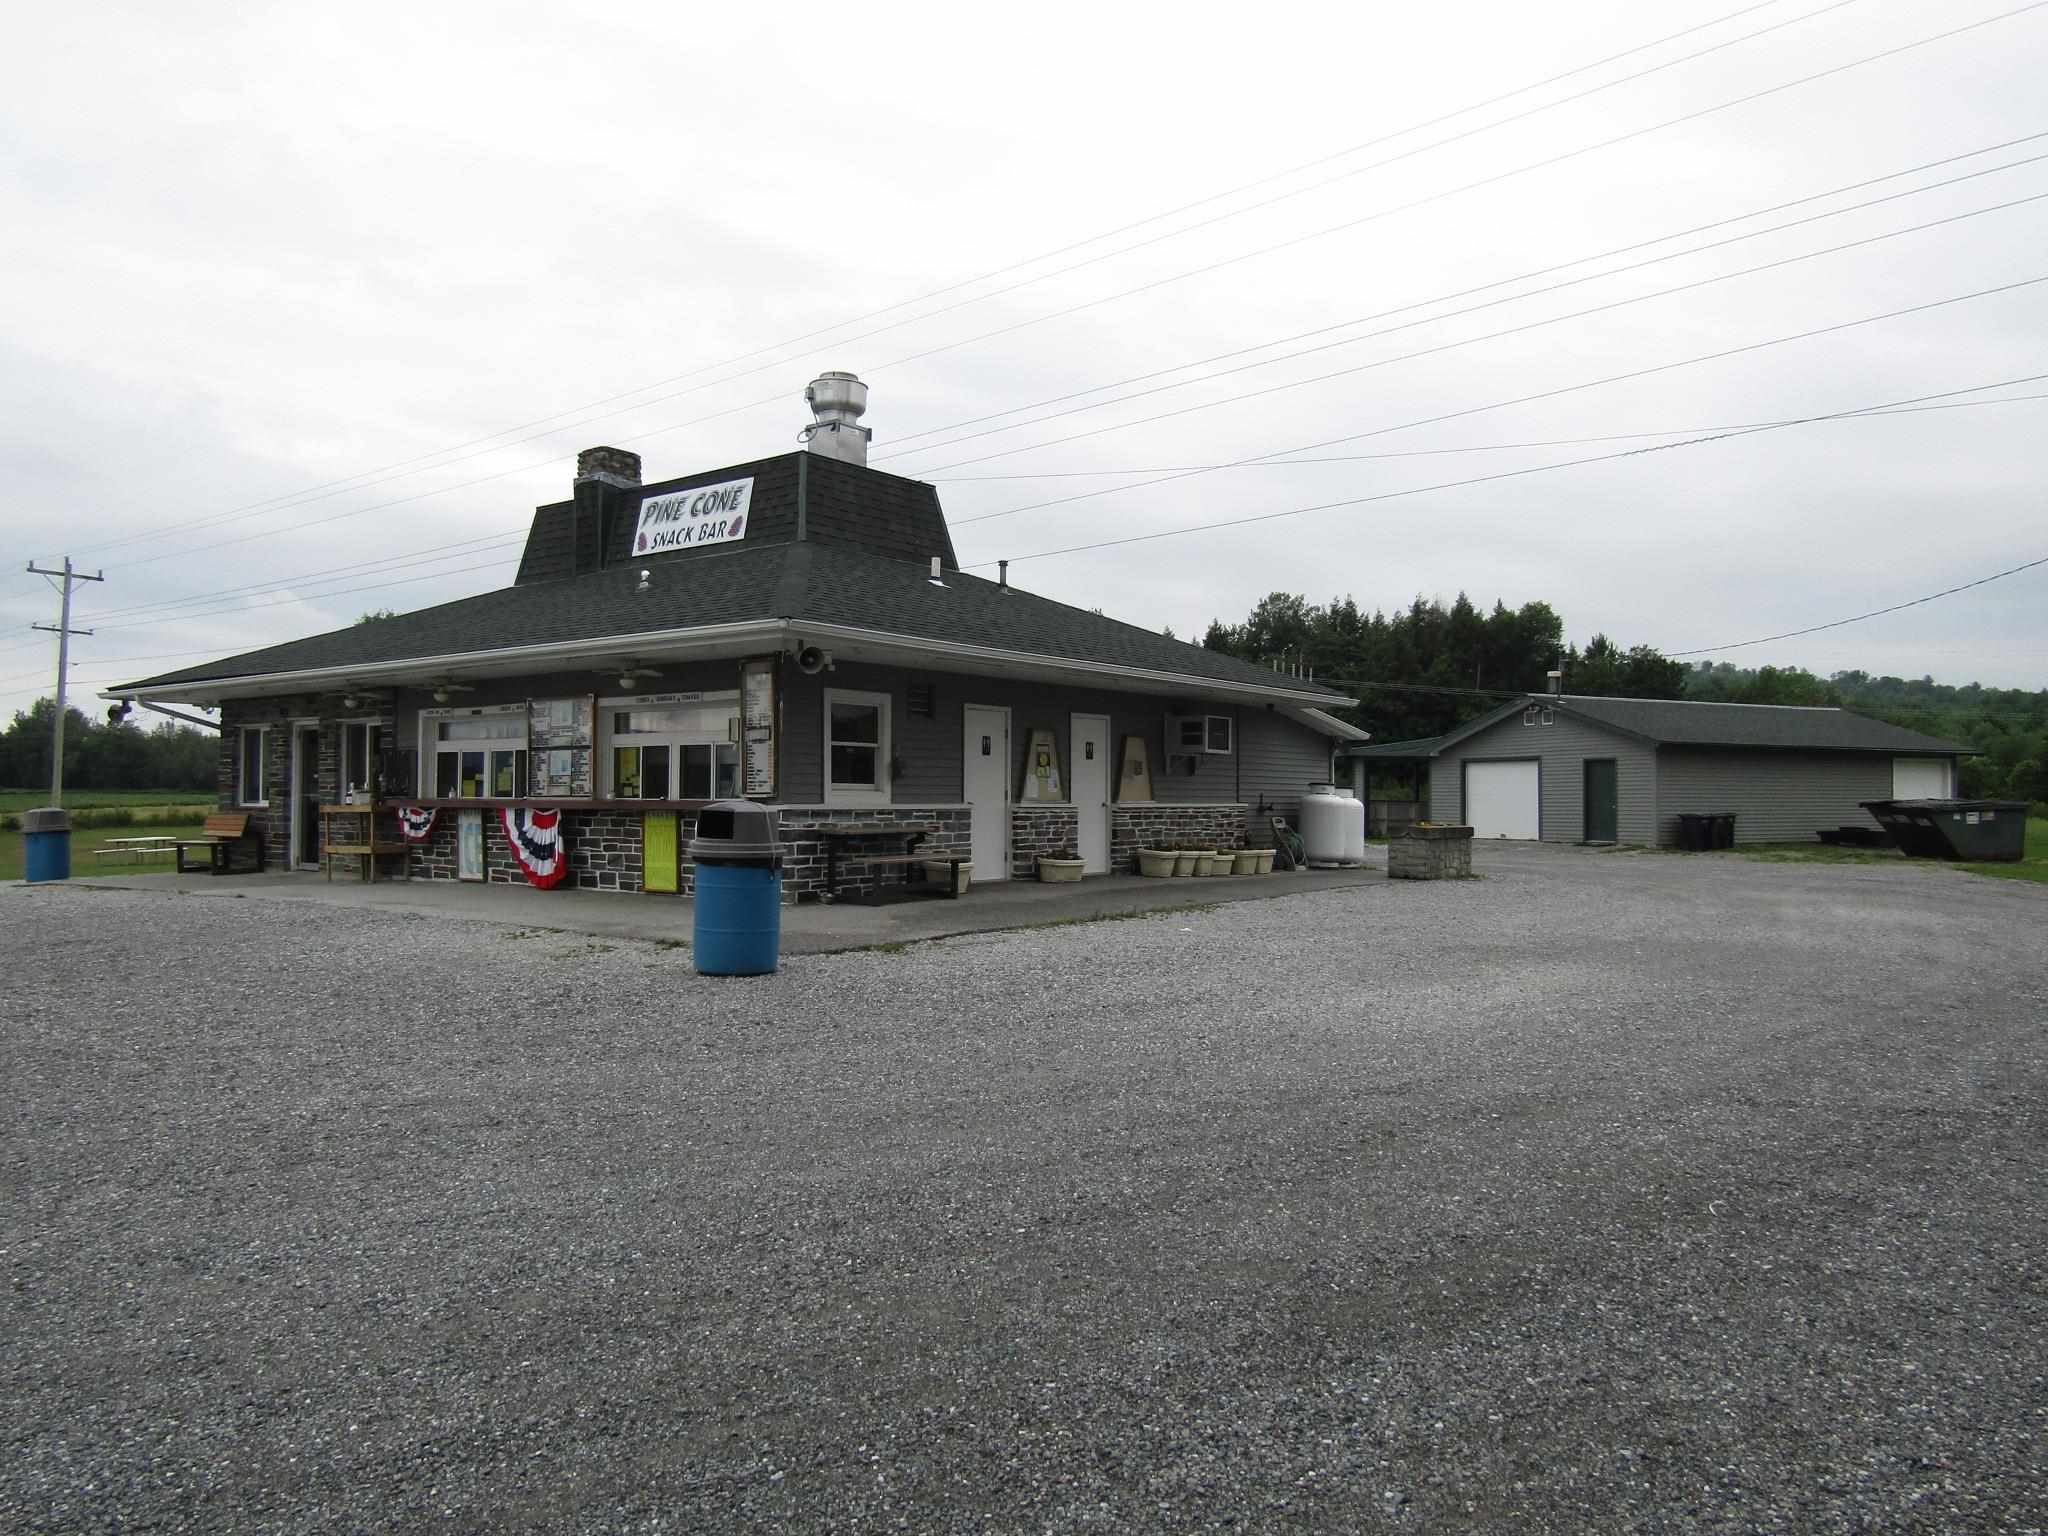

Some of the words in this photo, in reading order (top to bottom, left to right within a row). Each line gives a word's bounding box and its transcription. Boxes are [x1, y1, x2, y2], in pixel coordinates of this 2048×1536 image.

[642, 497, 687, 527] PINE
[690, 487, 744, 516] CONE
[651, 526, 694, 549] SNACK
[698, 520, 727, 541] BAR
